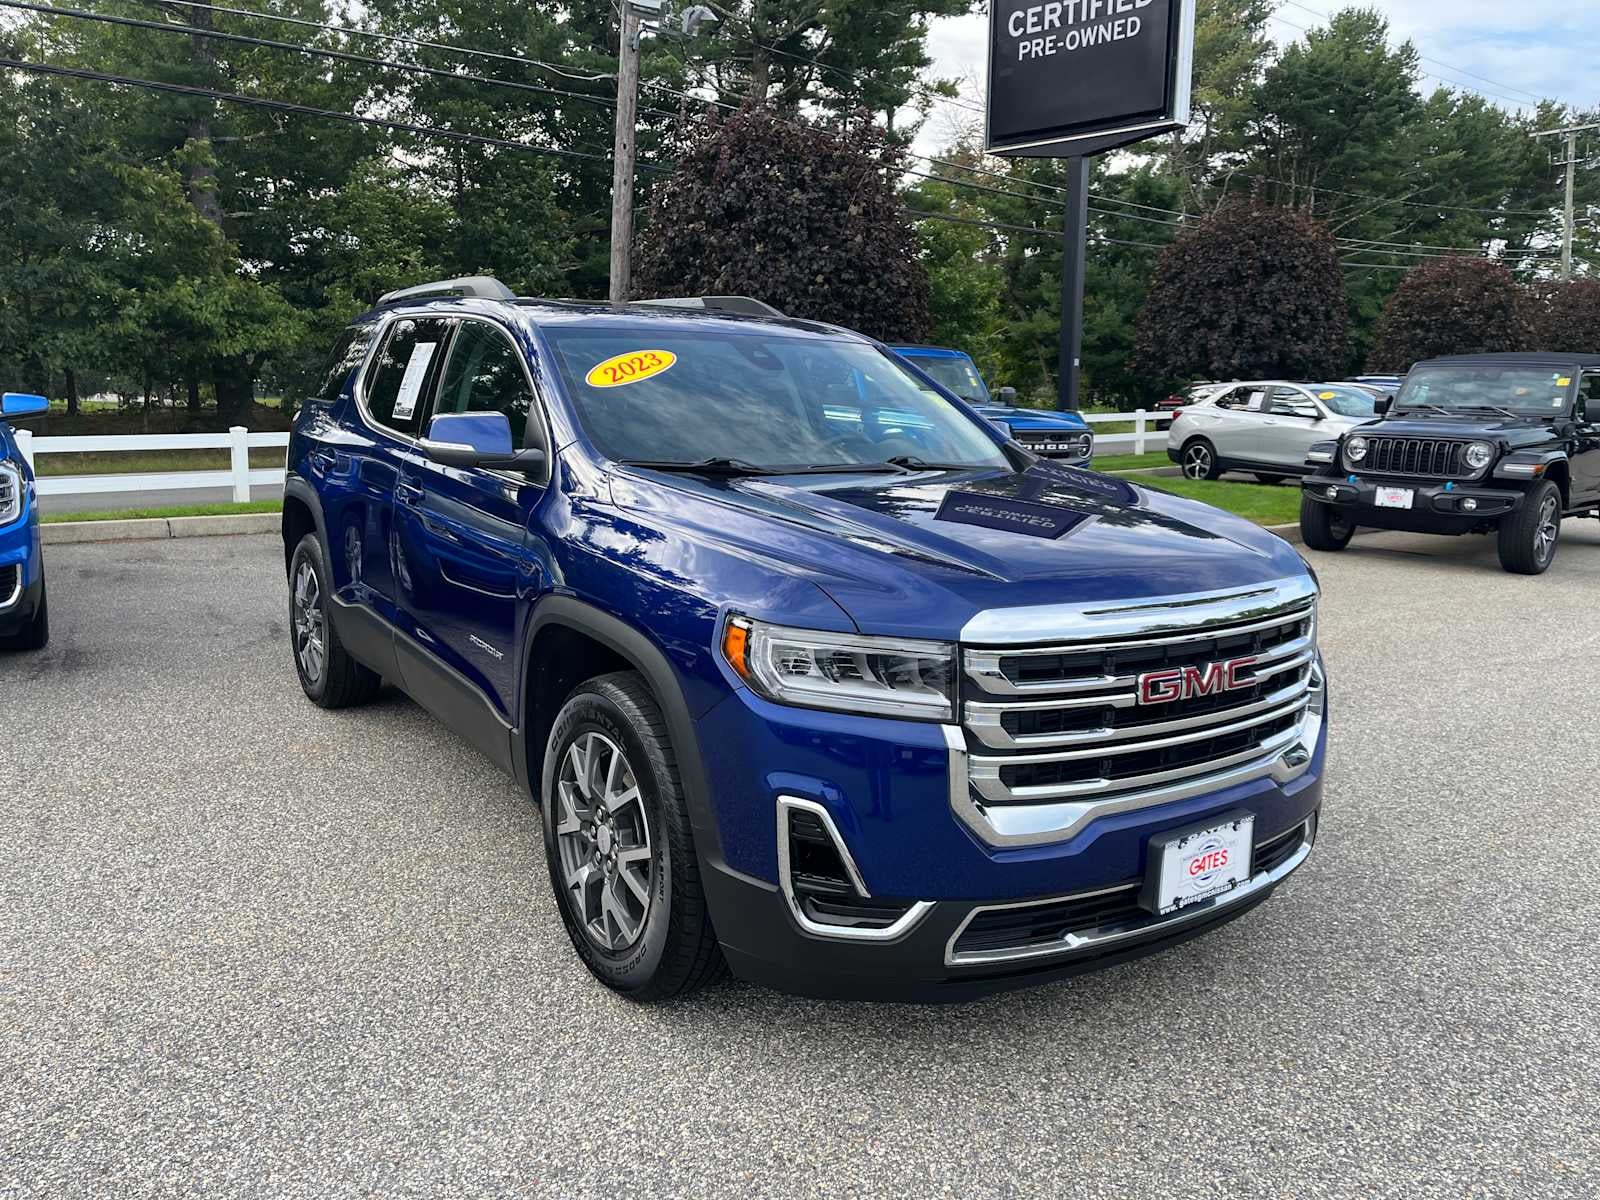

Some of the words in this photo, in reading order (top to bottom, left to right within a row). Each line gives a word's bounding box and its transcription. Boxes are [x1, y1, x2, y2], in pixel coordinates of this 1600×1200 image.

[1008, 0, 1153, 37] CERTIFIE
[1018, 16, 1141, 61] PRE-OWNED
[603, 352, 663, 383] 2023
[1022, 443, 1069, 451] ONCO
[1138, 656, 1258, 705] GMC
[1188, 849, 1229, 876] GATES
